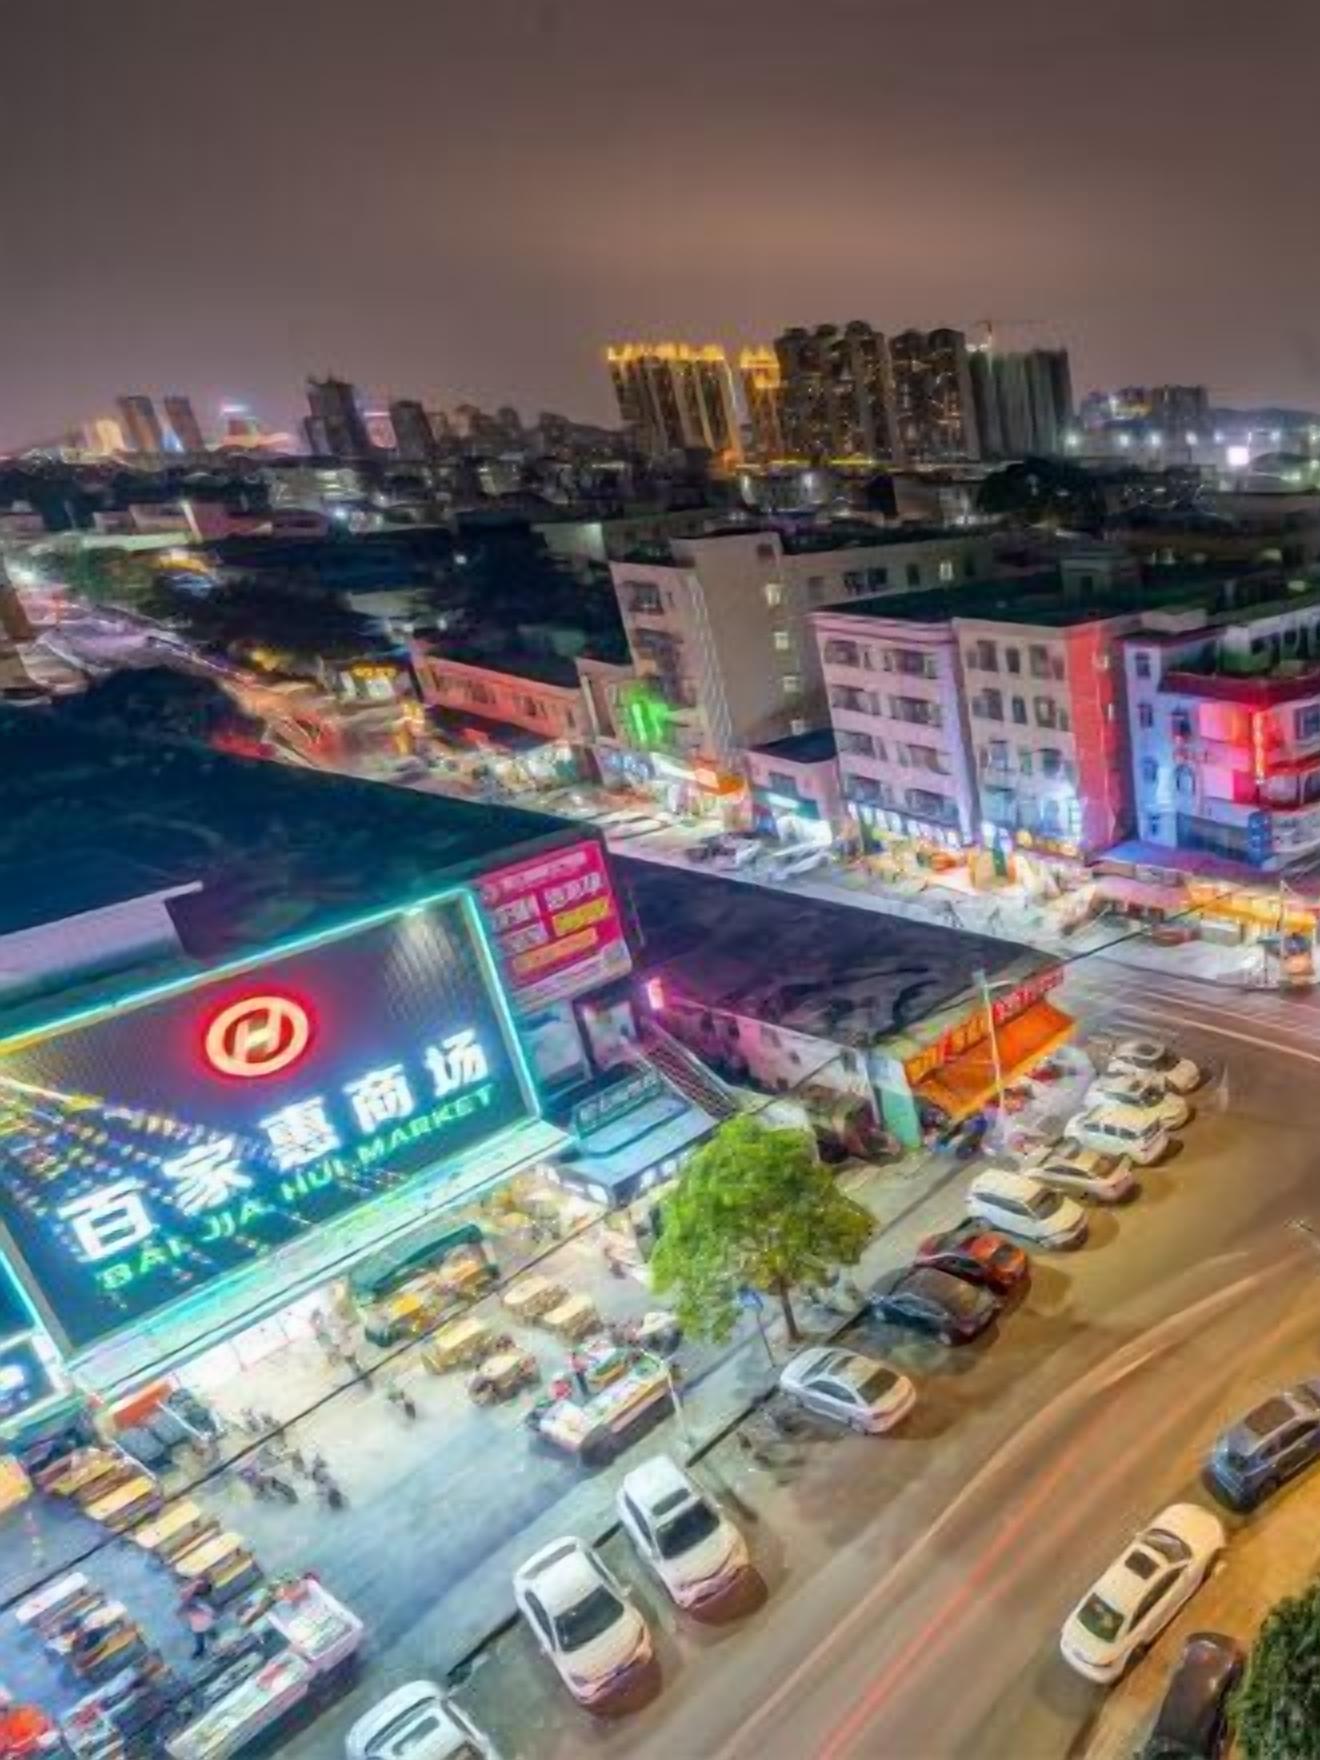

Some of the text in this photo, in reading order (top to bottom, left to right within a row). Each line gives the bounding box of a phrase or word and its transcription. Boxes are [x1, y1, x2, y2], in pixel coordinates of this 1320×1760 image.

[102, 1238, 182, 1290] BAI
[281, 1157, 346, 1201] HUI
[357, 1083, 493, 1166] MARKET
